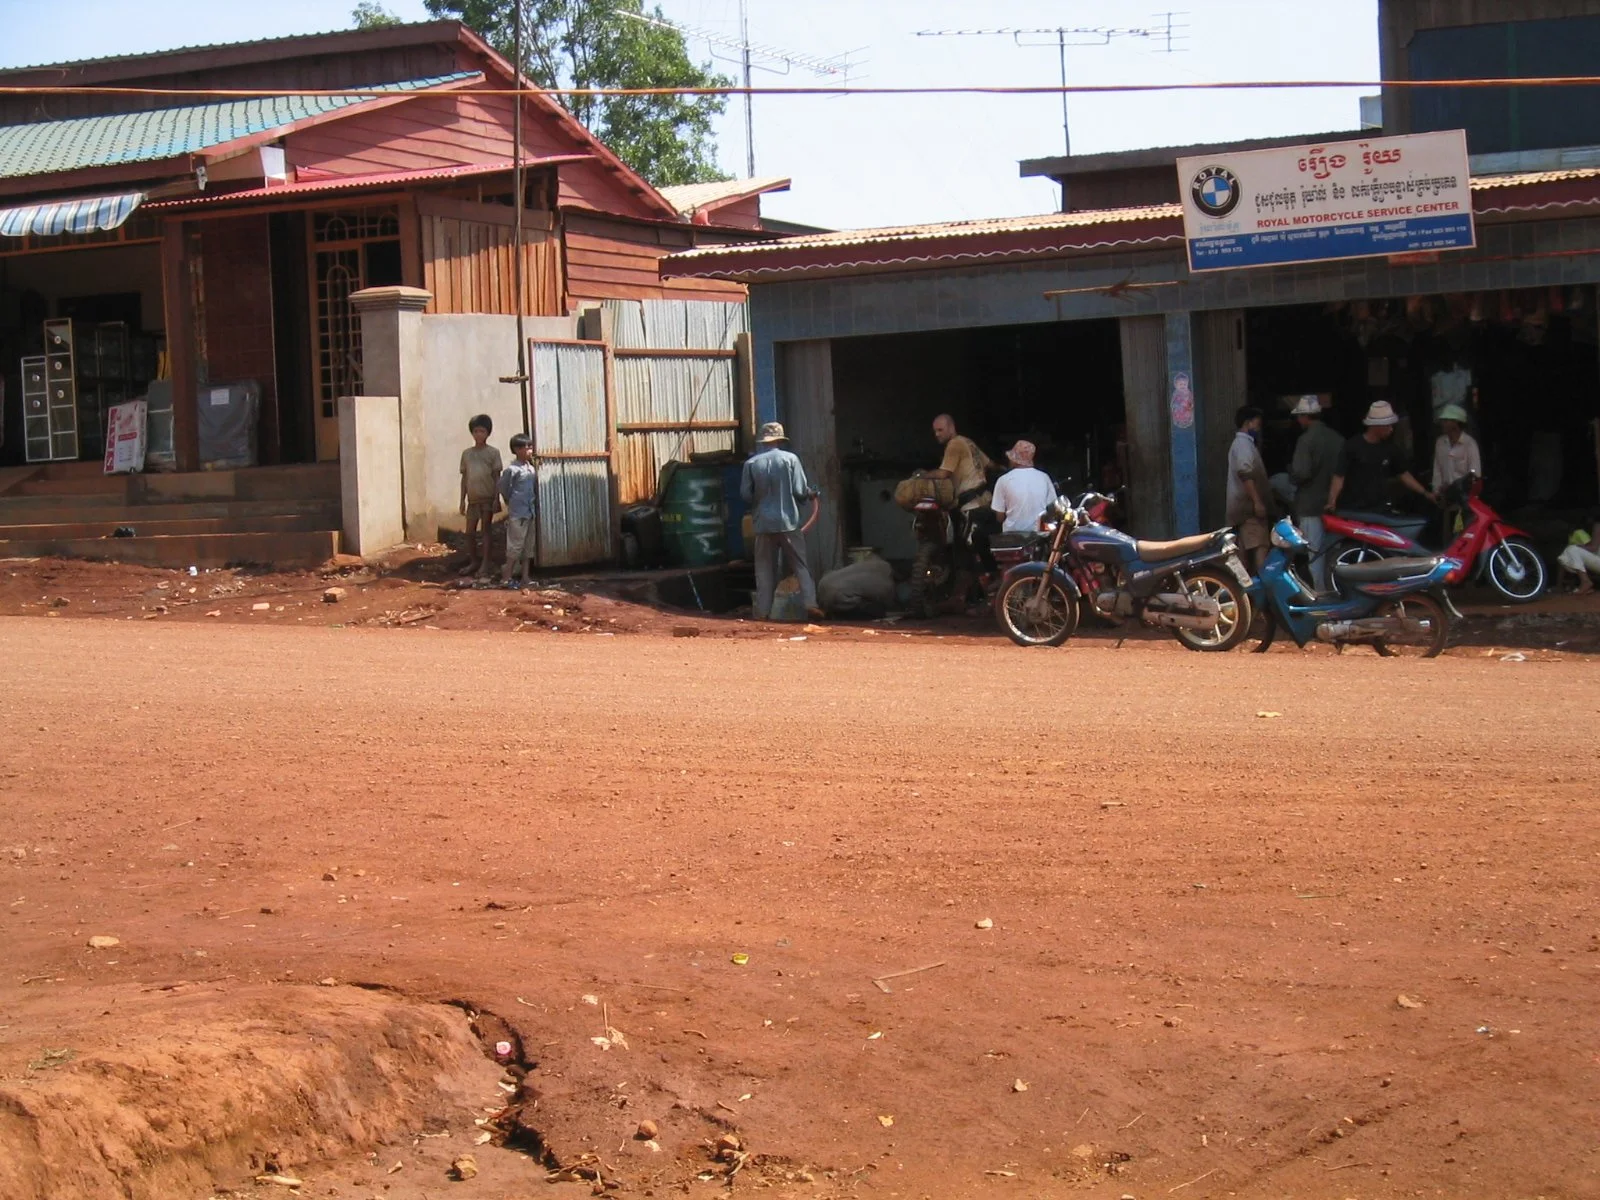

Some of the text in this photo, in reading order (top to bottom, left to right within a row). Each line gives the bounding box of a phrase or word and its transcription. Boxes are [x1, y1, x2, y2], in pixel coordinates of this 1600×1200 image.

[1193, 167, 1236, 190] ROYAL
[1257, 218, 1290, 228] ROYAL
[1293, 210, 1364, 225] MOTORCYCLE
[1367, 206, 1413, 218] SERVICE
[1416, 201, 1459, 215] CENTER
